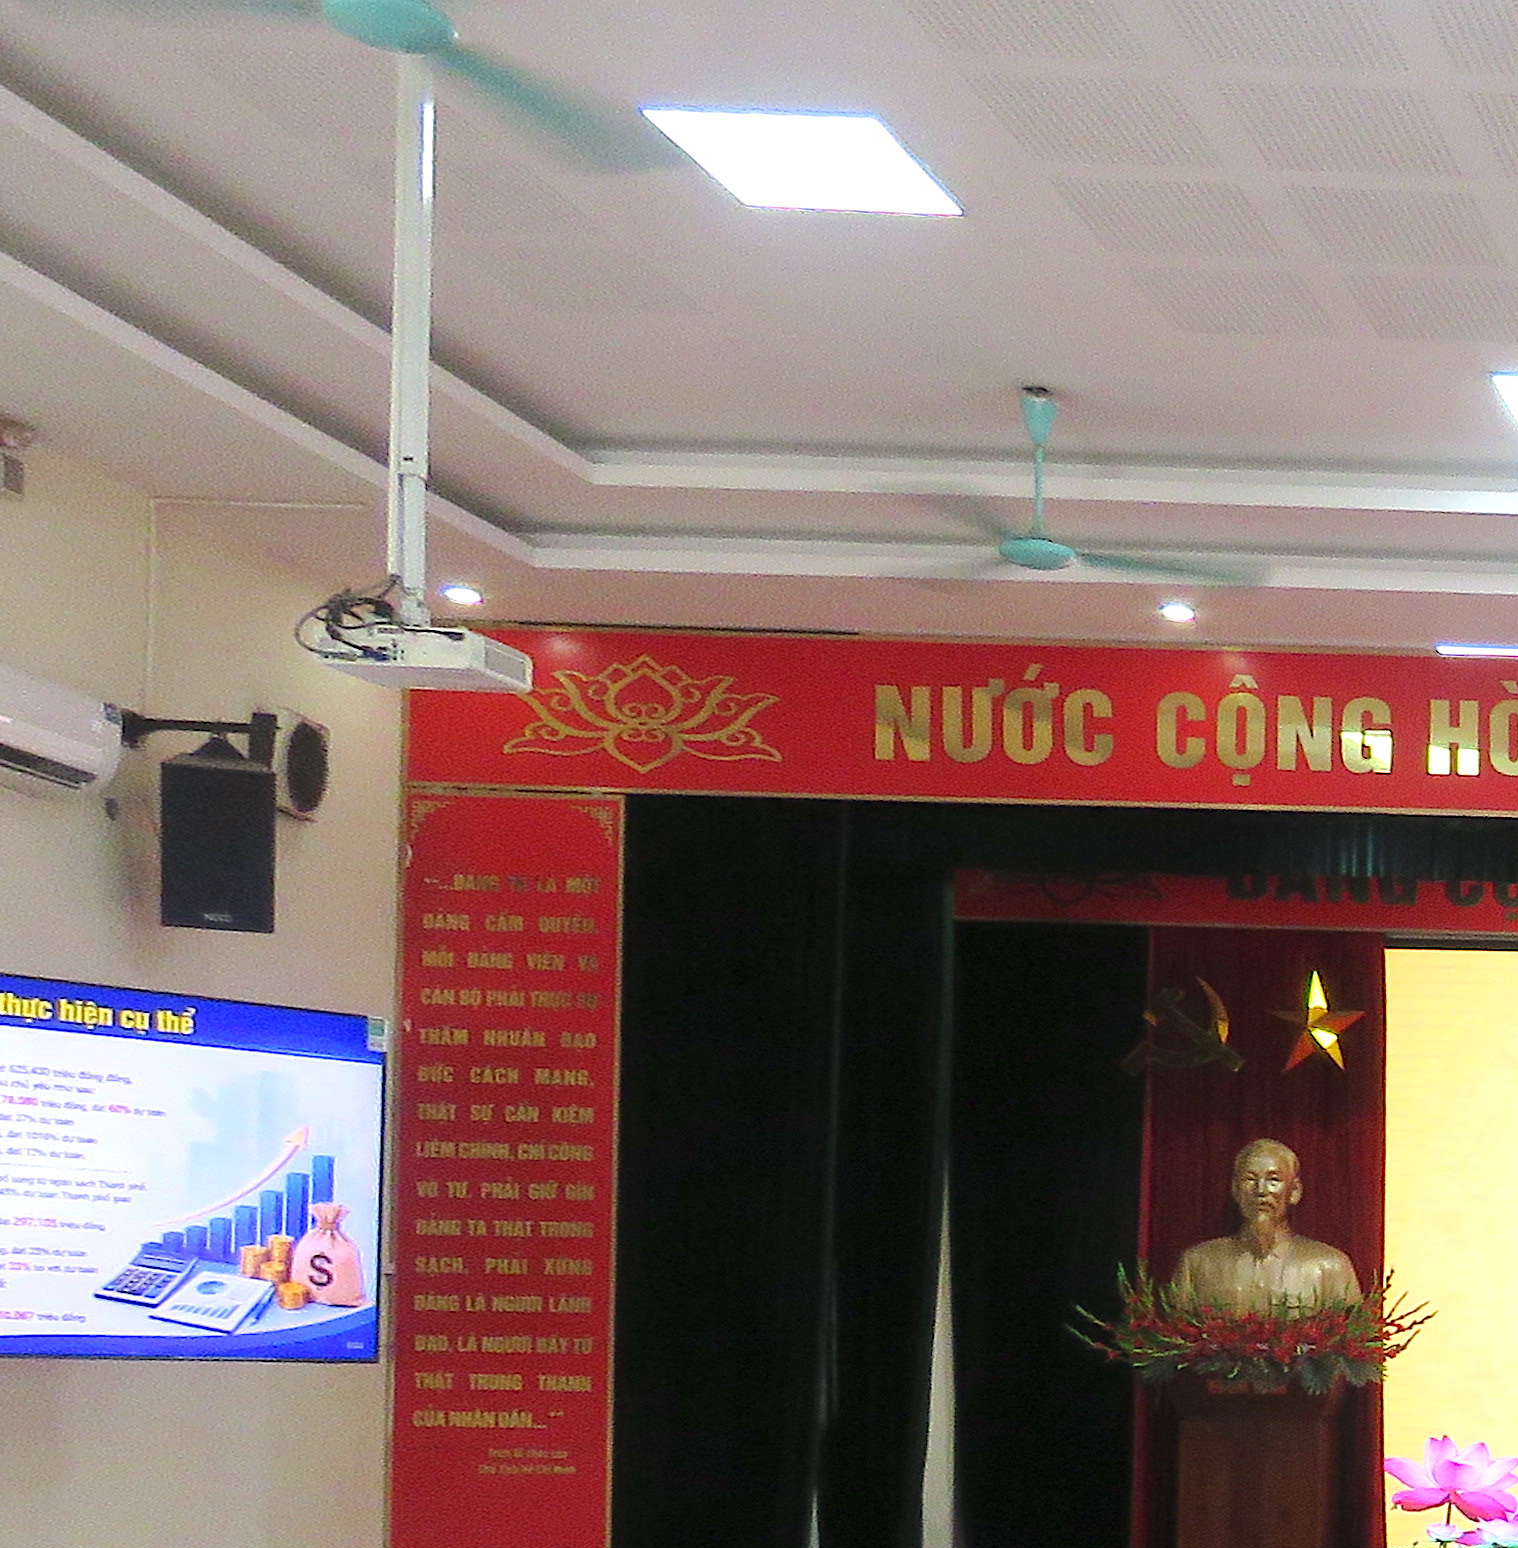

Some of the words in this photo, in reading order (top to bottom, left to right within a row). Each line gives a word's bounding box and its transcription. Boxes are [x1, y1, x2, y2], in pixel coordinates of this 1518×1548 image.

[873, 662, 1114, 767] NƯỚC
[1155, 674, 1395, 787] CỘNG
[58, 999, 113, 1029] hiện
[119, 1010, 150, 1035] cụ
[156, 1006, 197, 1035] thể
